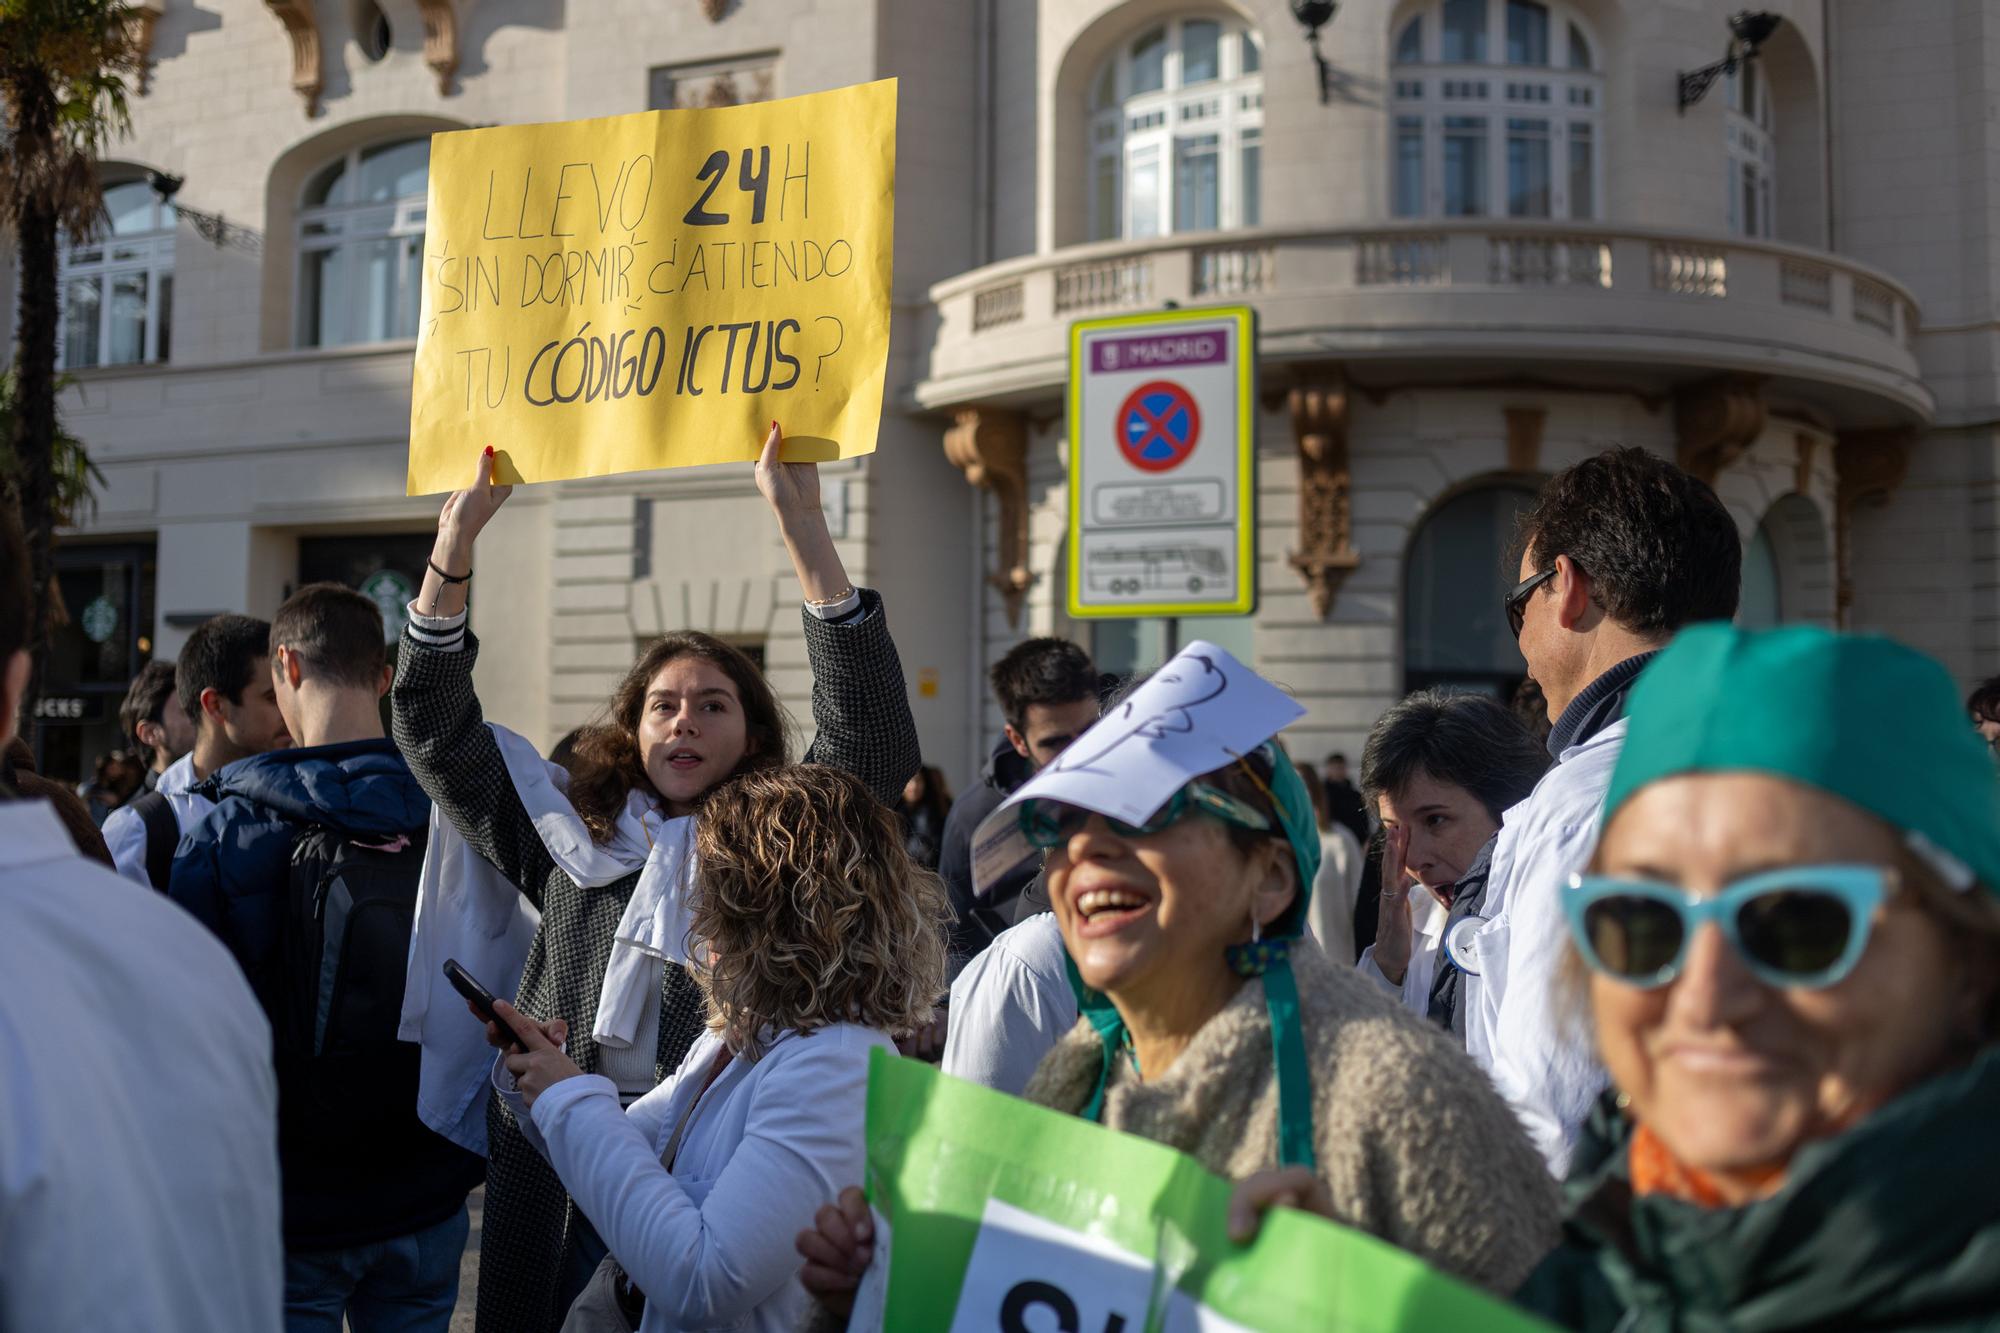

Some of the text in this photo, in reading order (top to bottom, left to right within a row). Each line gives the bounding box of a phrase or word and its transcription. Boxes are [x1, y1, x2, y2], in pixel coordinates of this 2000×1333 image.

[483, 141, 810, 240] LLEVO 24H
[438, 237, 852, 314] SIN DORMIR ¿ATIENDO
[456, 346, 509, 412] TU
[524, 321, 666, 407] CÓDIGO
[1128, 336, 1217, 365] MADRID
